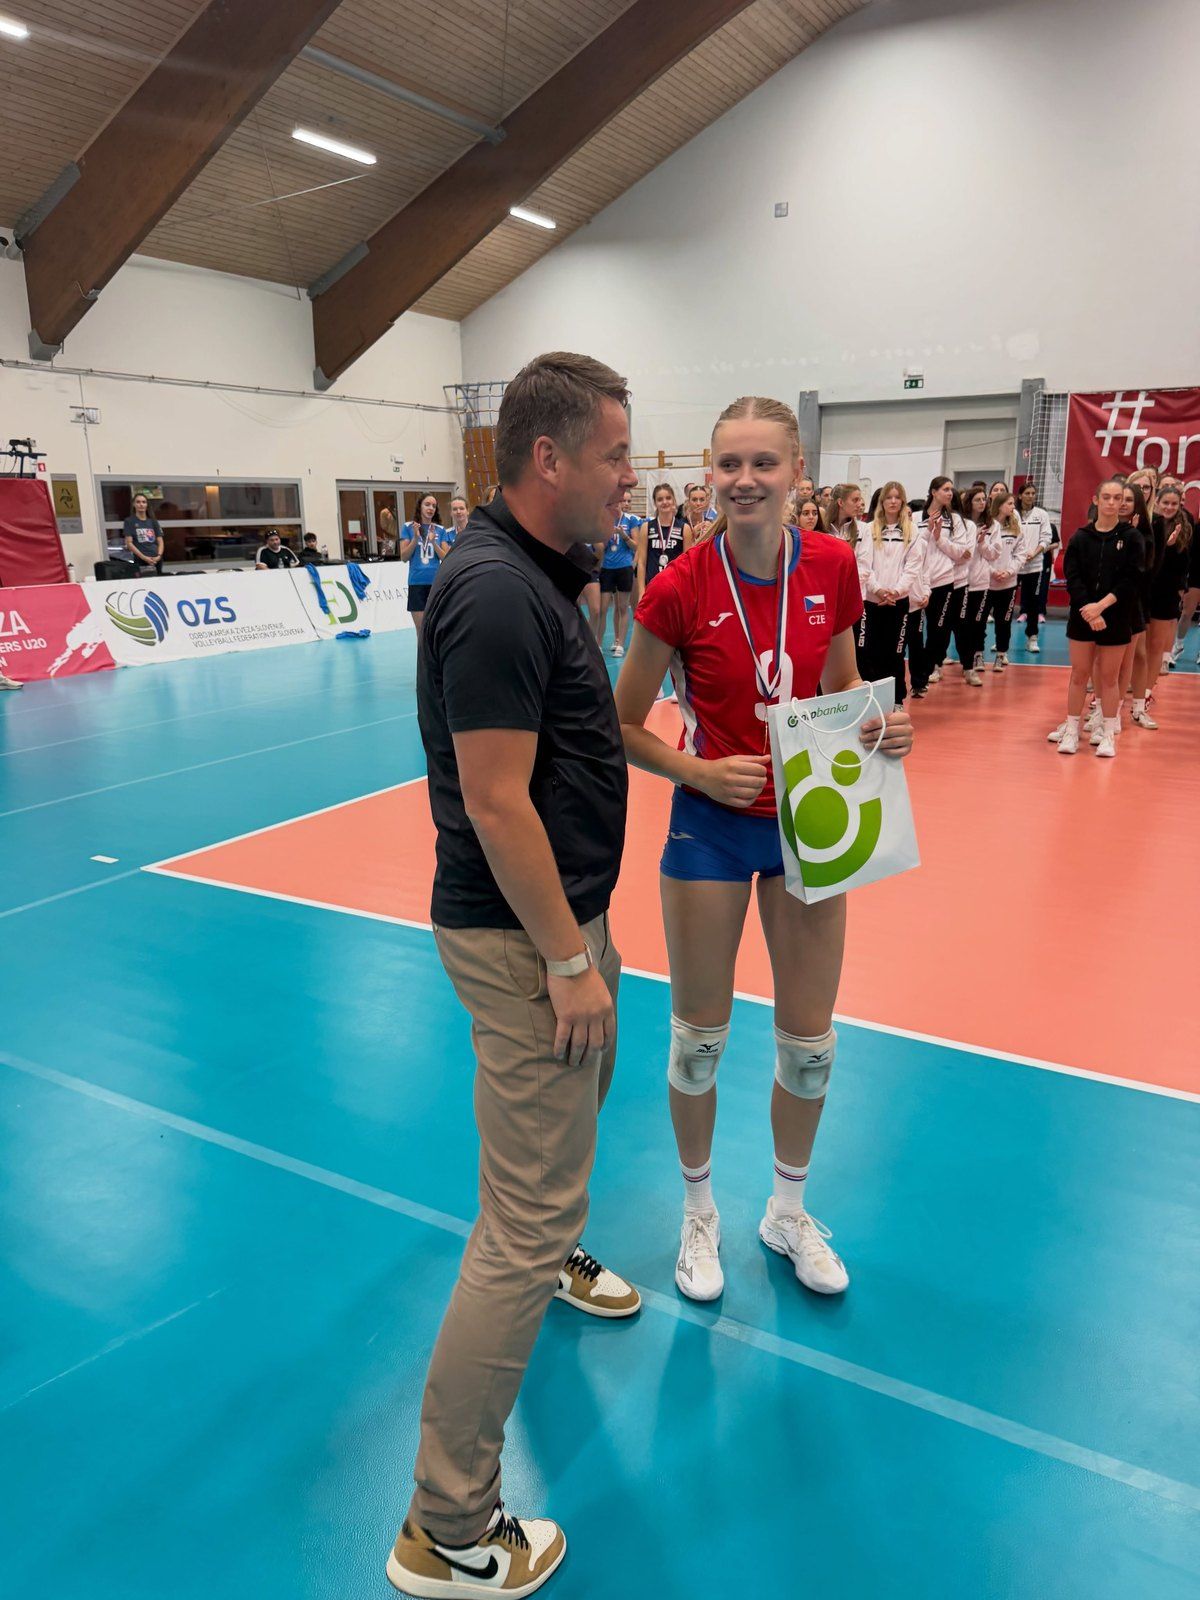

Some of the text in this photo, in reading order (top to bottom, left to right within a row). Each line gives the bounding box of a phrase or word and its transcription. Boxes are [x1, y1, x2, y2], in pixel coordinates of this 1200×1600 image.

[177, 596, 236, 627] OZS
[808, 614, 826, 625] CZE
[22, 637, 47, 650] U20
[192, 637, 233, 648] VOLLEYBALL
[896, 614, 908, 653] GIVOVA
[755, 649, 793, 721] 9
